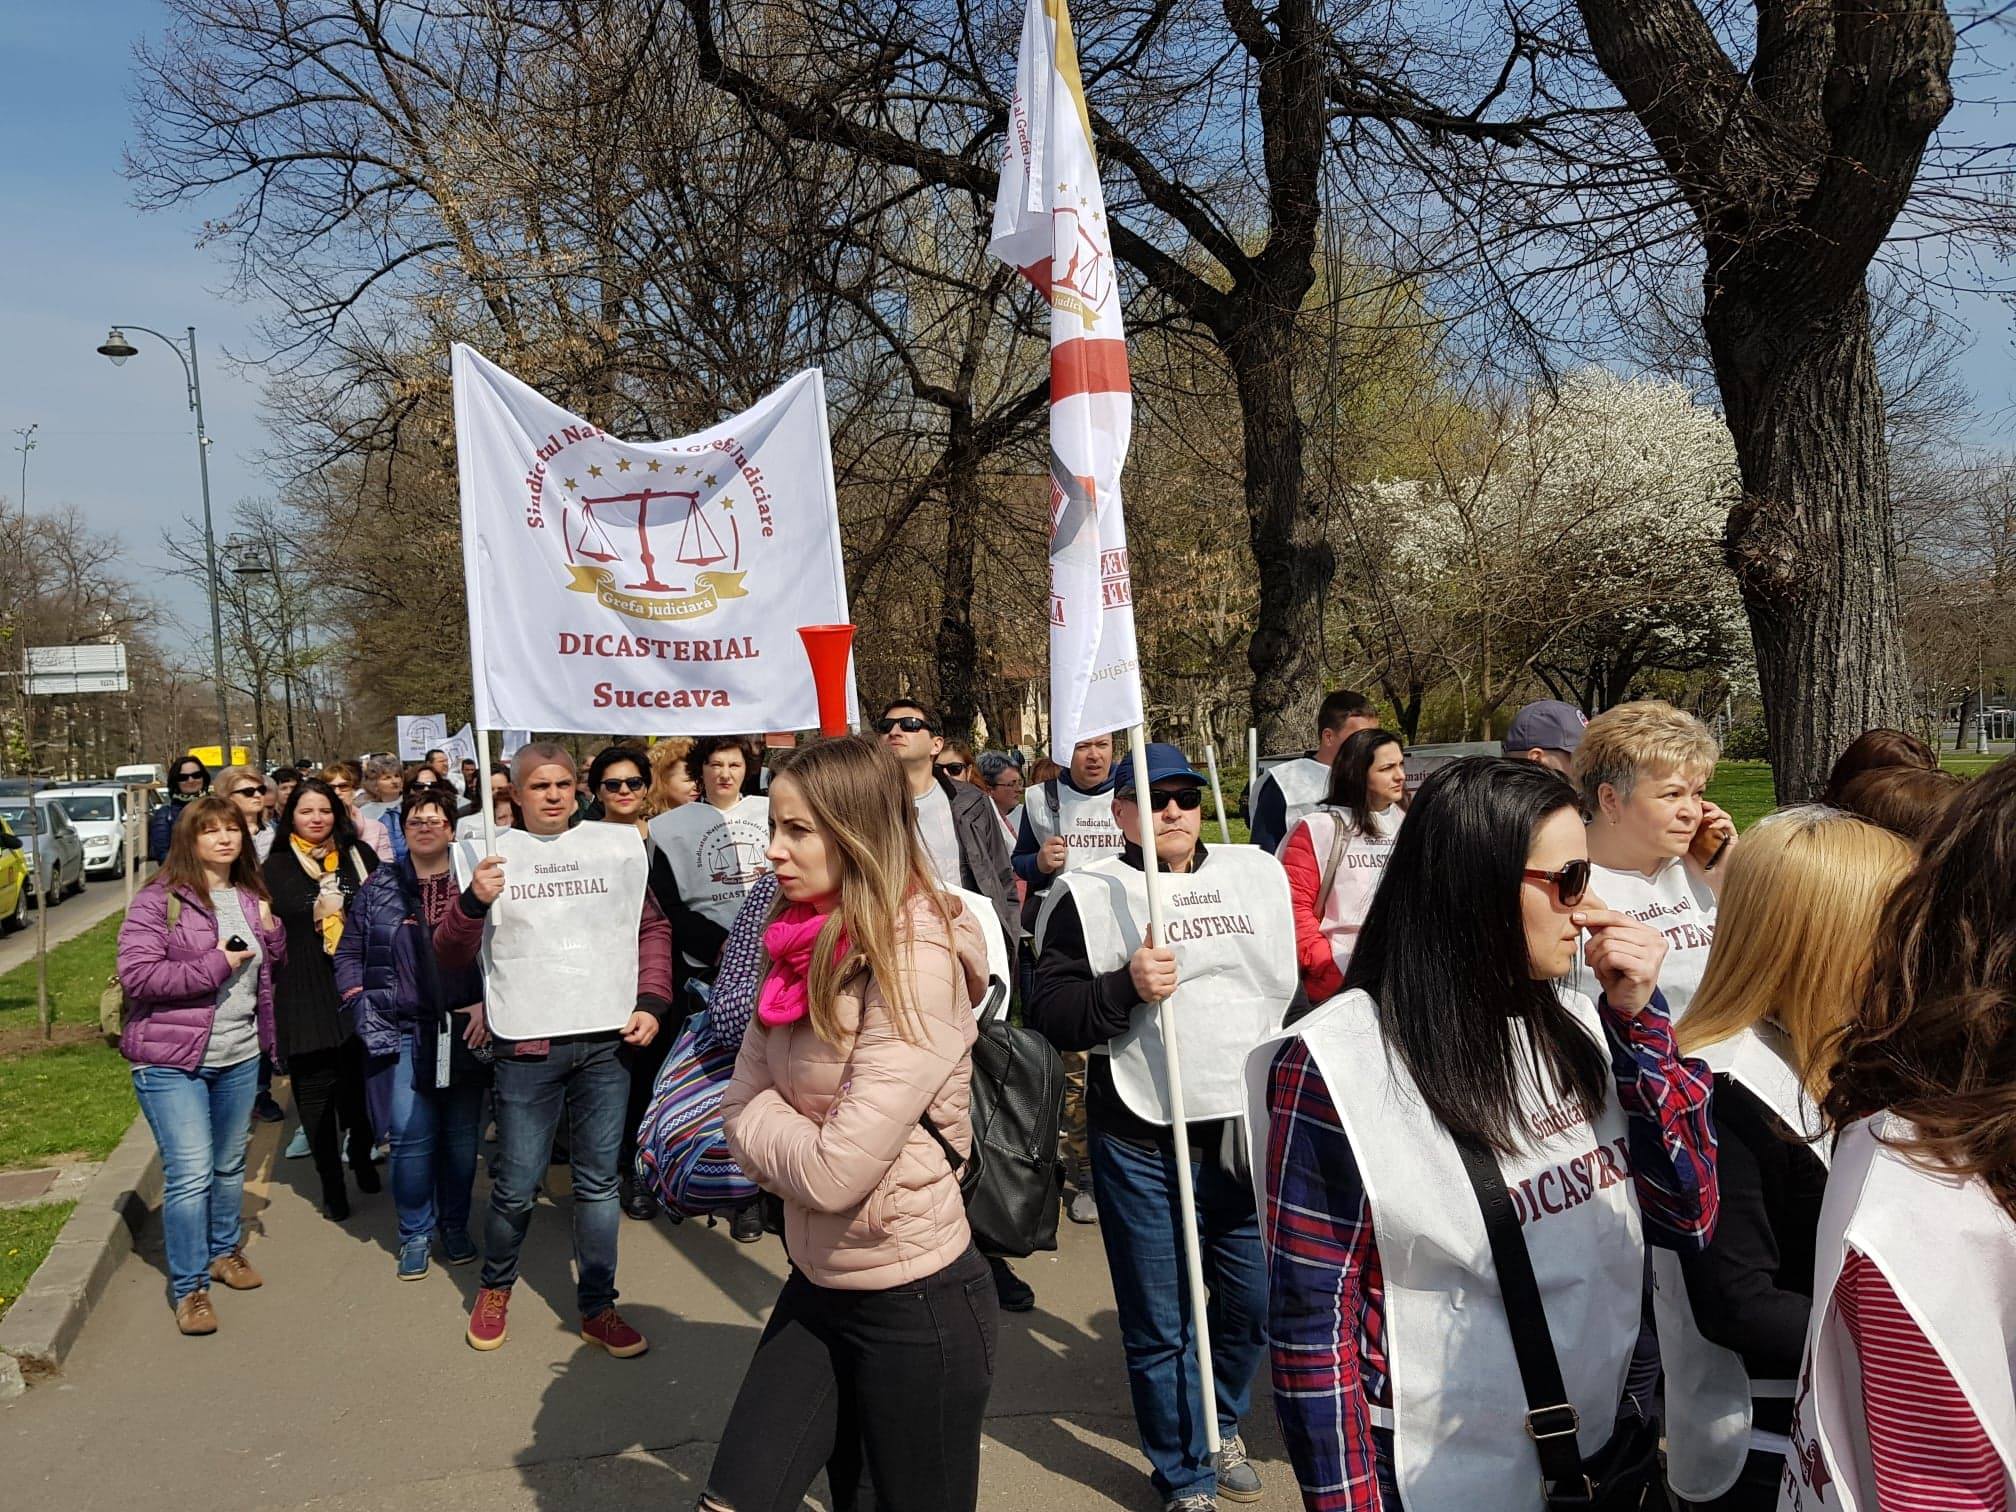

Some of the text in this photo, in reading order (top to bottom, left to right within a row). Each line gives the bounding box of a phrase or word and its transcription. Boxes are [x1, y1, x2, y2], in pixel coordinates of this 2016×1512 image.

[526, 434, 564, 528] Sindicatul
[603, 592, 712, 618] Grefa judiciară
[559, 632, 760, 661] DICASTERIAL
[594, 682, 730, 708] Suceava
[1076, 817, 1111, 827] Sindicatul
[1062, 834, 1125, 848] ICASTERIA
[534, 861, 579, 874] Sindicatul
[1347, 854, 1388, 868] DICAST
[510, 878, 608, 900] DICASTERIAL
[712, 889, 751, 901] DICAST
[1172, 889, 1222, 907] Sindicatul
[1625, 896, 1691, 922] Sindictul
[1163, 914, 1255, 945] ICASTERIAL
